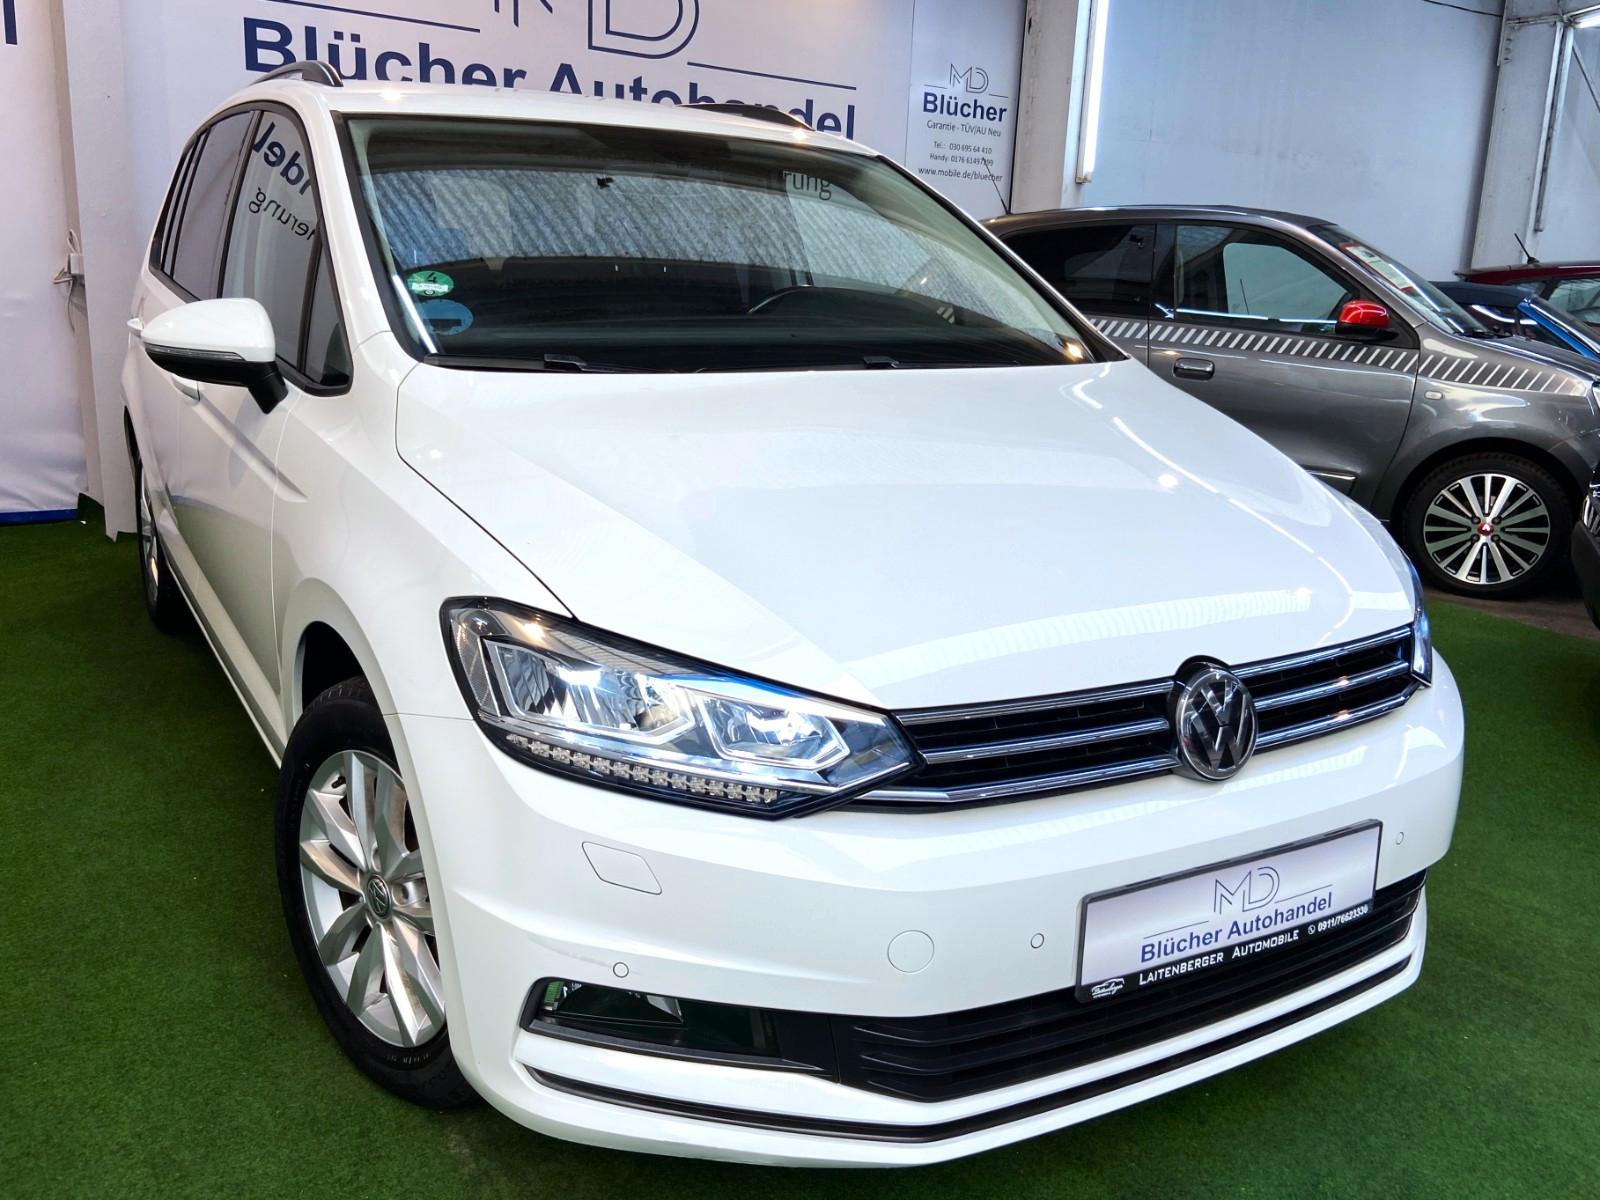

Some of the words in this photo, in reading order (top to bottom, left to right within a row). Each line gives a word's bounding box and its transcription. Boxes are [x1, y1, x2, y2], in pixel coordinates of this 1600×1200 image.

[243, 17, 528, 89] Blücher
[923, 91, 1008, 123] Blücher
[926, 120, 956, 132] Garantie
[987, 127, 1002, 137] Neu
[1140, 928, 1223, 964] Blücher
[1227, 891, 1332, 940] Autohandel
[1139, 952, 1224, 986] LAITENBERGER
[1232, 929, 1300, 959] AUTOMOBILE
